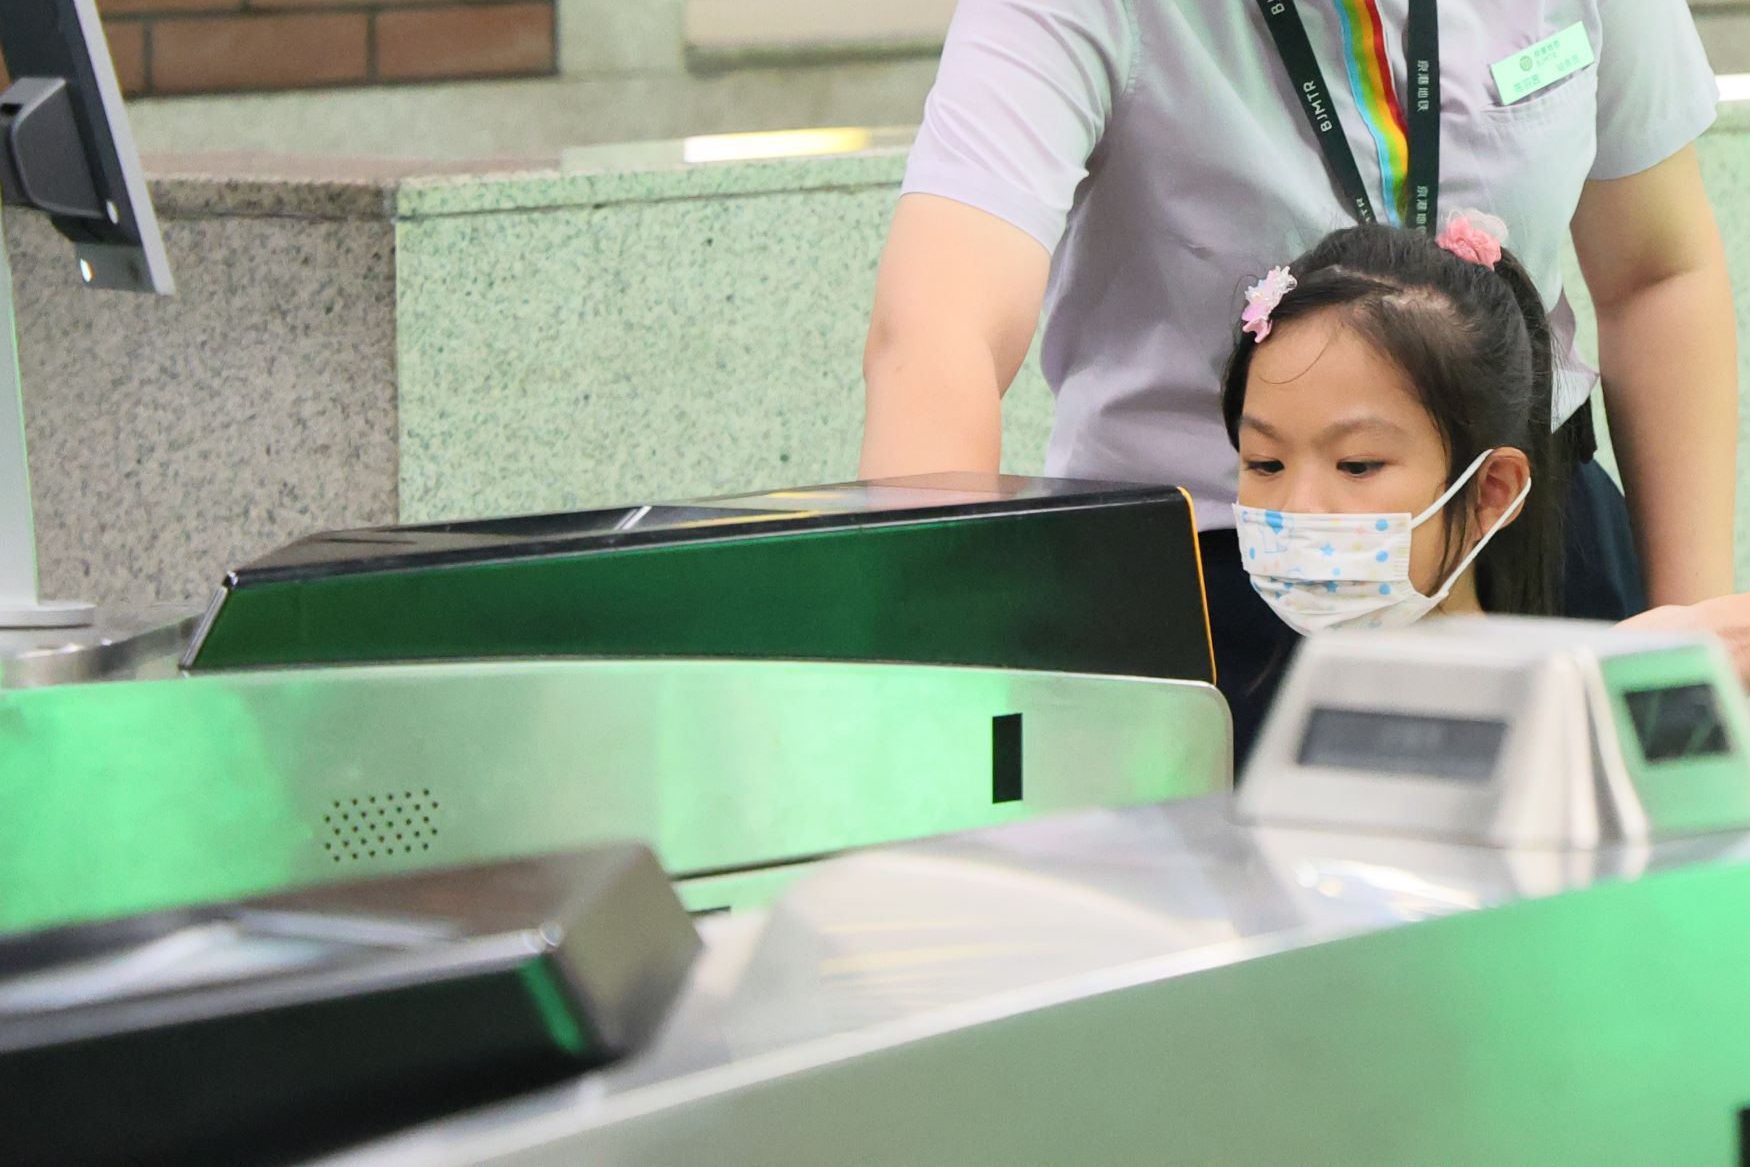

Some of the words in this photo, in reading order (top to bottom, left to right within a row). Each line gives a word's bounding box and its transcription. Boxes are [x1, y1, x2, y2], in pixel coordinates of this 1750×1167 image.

[1303, 79, 1333, 133] BJMTR
[1416, 60, 1430, 112] 京港地铁
